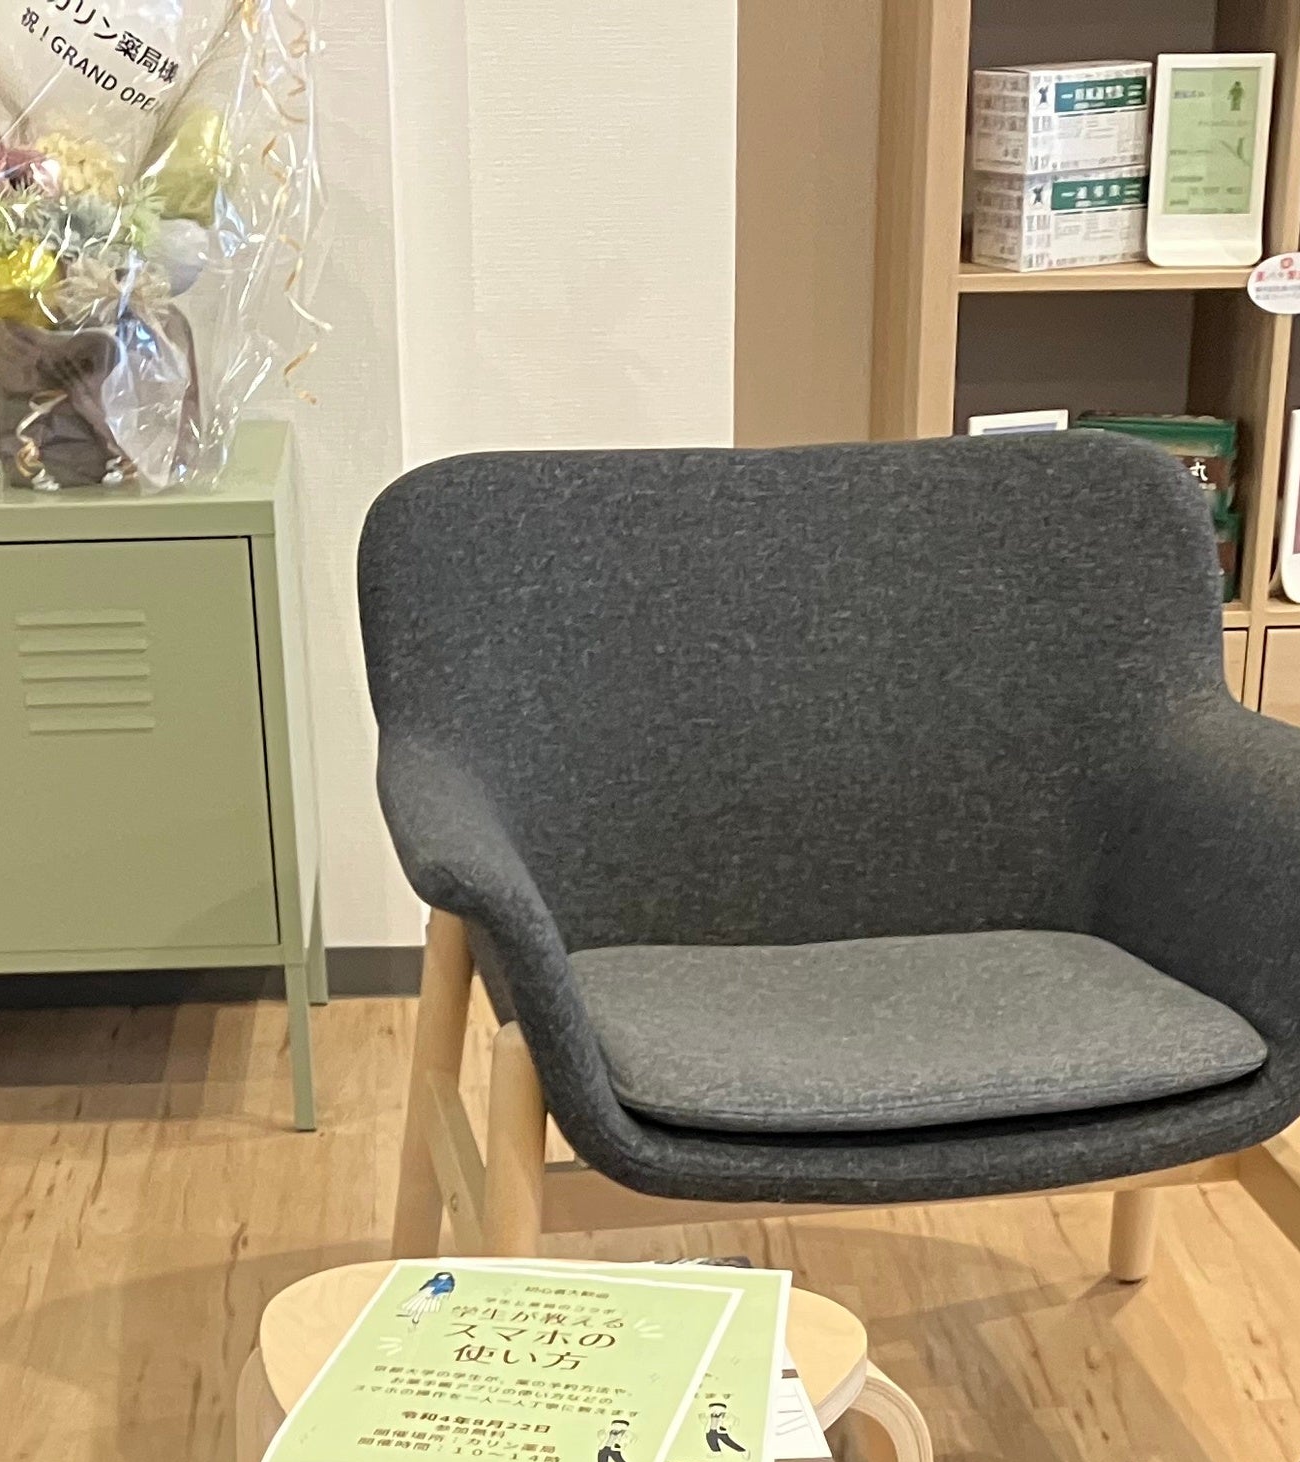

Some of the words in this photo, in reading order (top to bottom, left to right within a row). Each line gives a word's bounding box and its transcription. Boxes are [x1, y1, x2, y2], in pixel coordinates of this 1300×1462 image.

[50, 35, 118, 91] GRAND
[119, 86, 161, 112] OPE
[451, 1305, 625, 1330] 学生が教える
[444, 1322, 616, 1349] スマホの
[453, 1343, 588, 1370] 使い方
